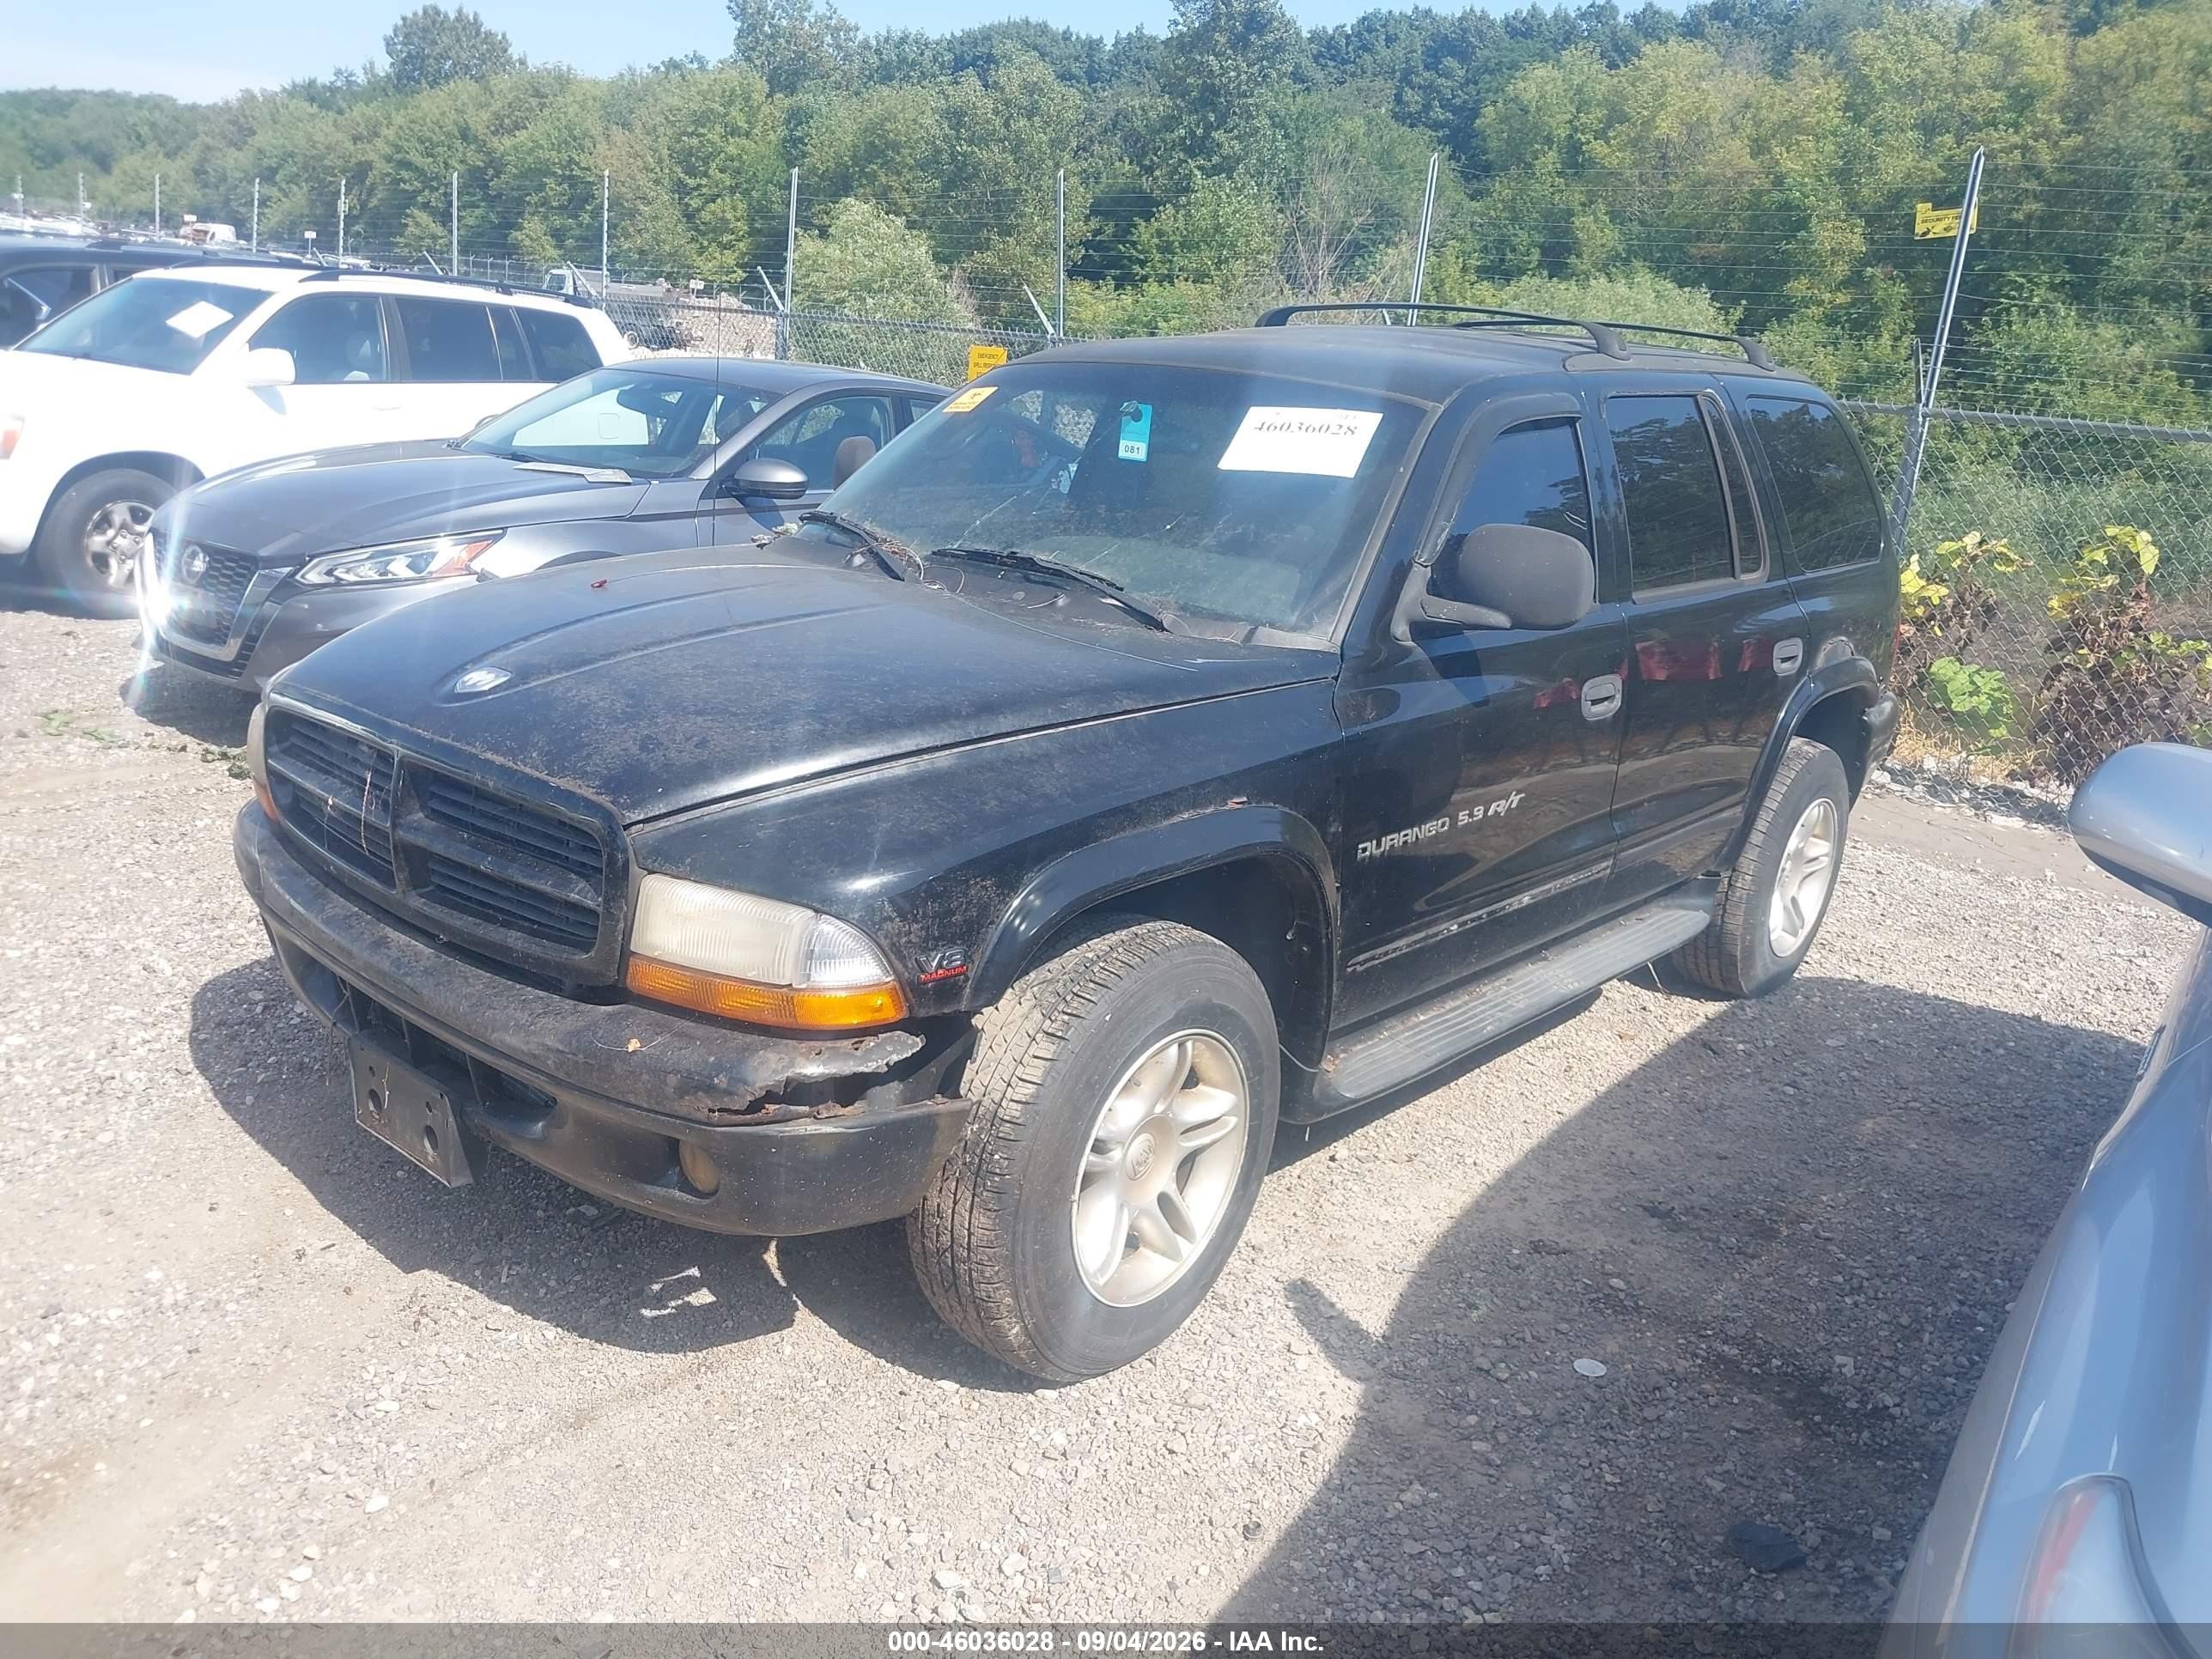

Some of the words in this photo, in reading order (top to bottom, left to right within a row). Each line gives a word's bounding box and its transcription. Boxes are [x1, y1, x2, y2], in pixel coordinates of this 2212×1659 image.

[1920, 216, 1951, 224] SECURITY
[1253, 421, 1358, 436] 46036028
[1124, 445, 1140, 454] 081
[1357, 817, 1450, 860] DURANGO
[1456, 805, 1484, 825] 5.9
[1487, 790, 1526, 817] R/T
[914, 949, 965, 973] V8
[920, 964, 968, 982] MAGNUM
